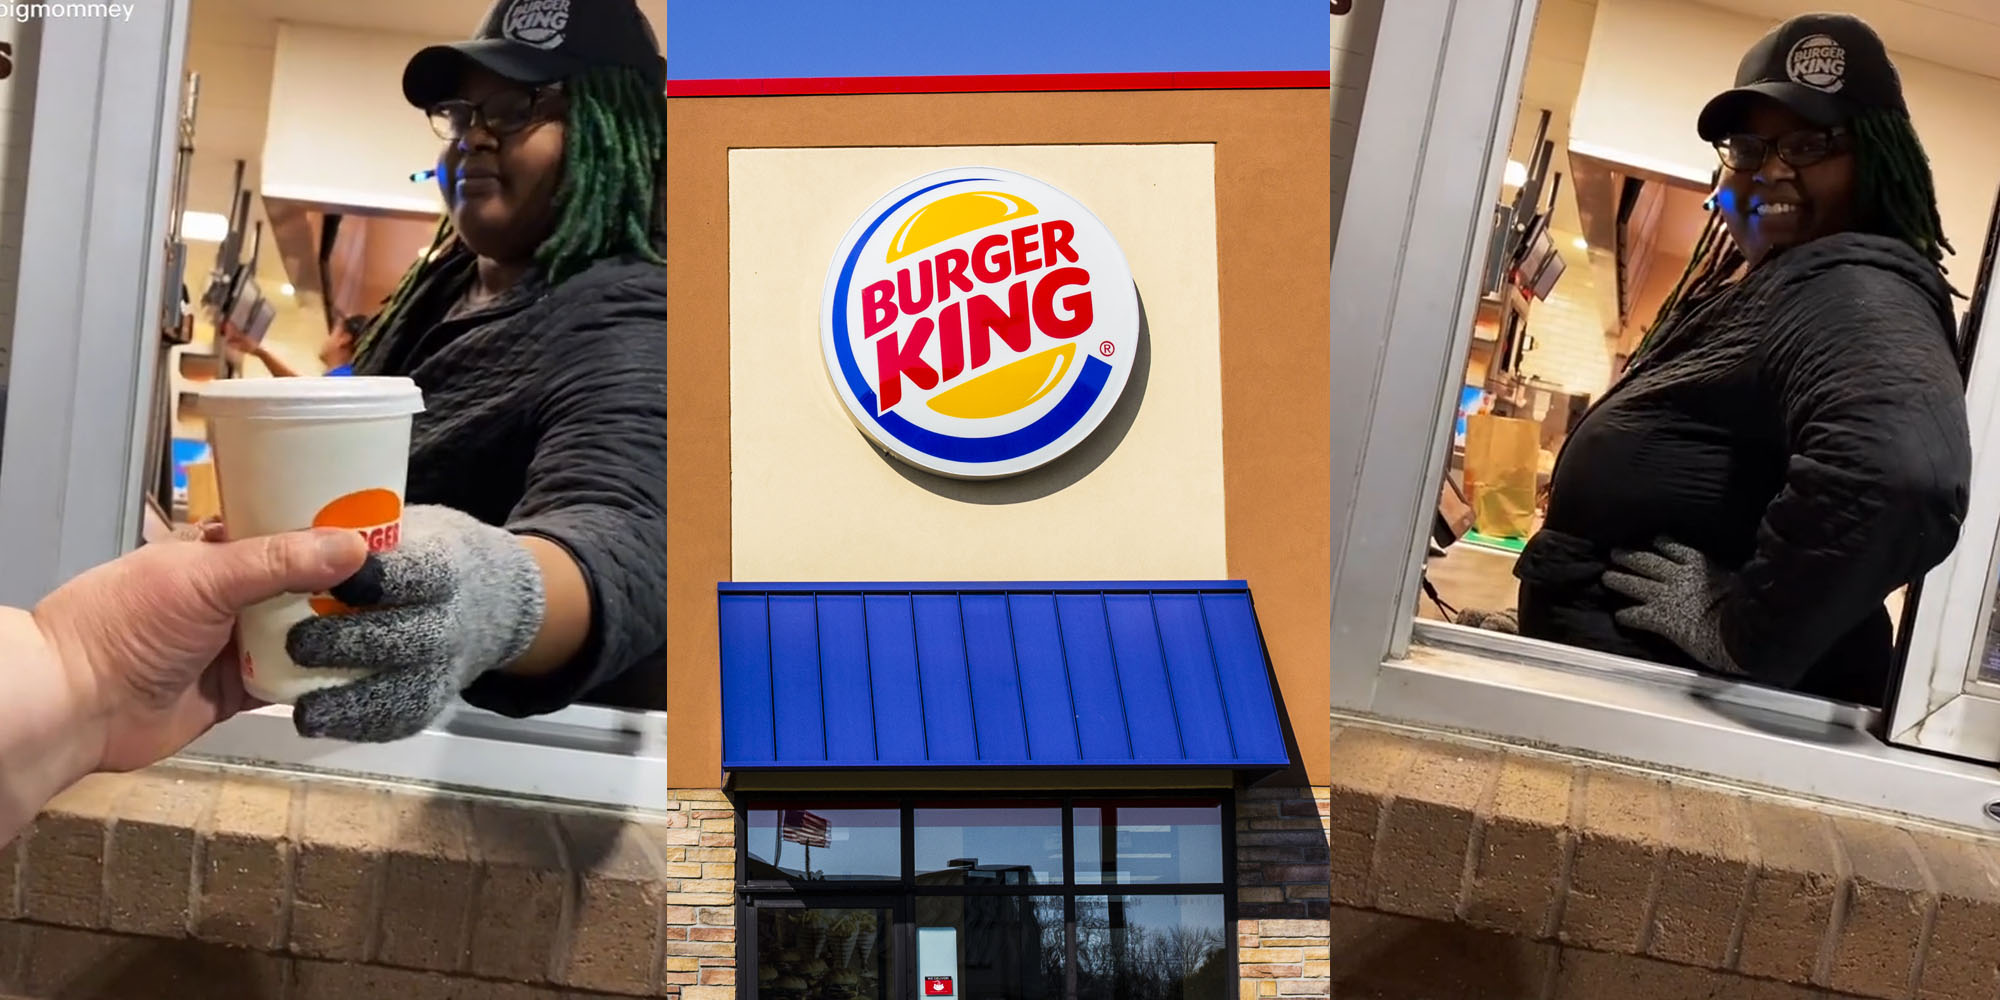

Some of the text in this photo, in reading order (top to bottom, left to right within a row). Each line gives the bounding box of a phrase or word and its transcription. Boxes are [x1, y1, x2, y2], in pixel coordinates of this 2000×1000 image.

[511, 0, 571, 17] BURGER
[506, 10, 569, 33] KING
[1793, 47, 1846, 63] BURGER
[1791, 58, 1845, 77] KING
[861, 219, 1079, 339] BURGER
[876, 266, 1094, 412] KING
